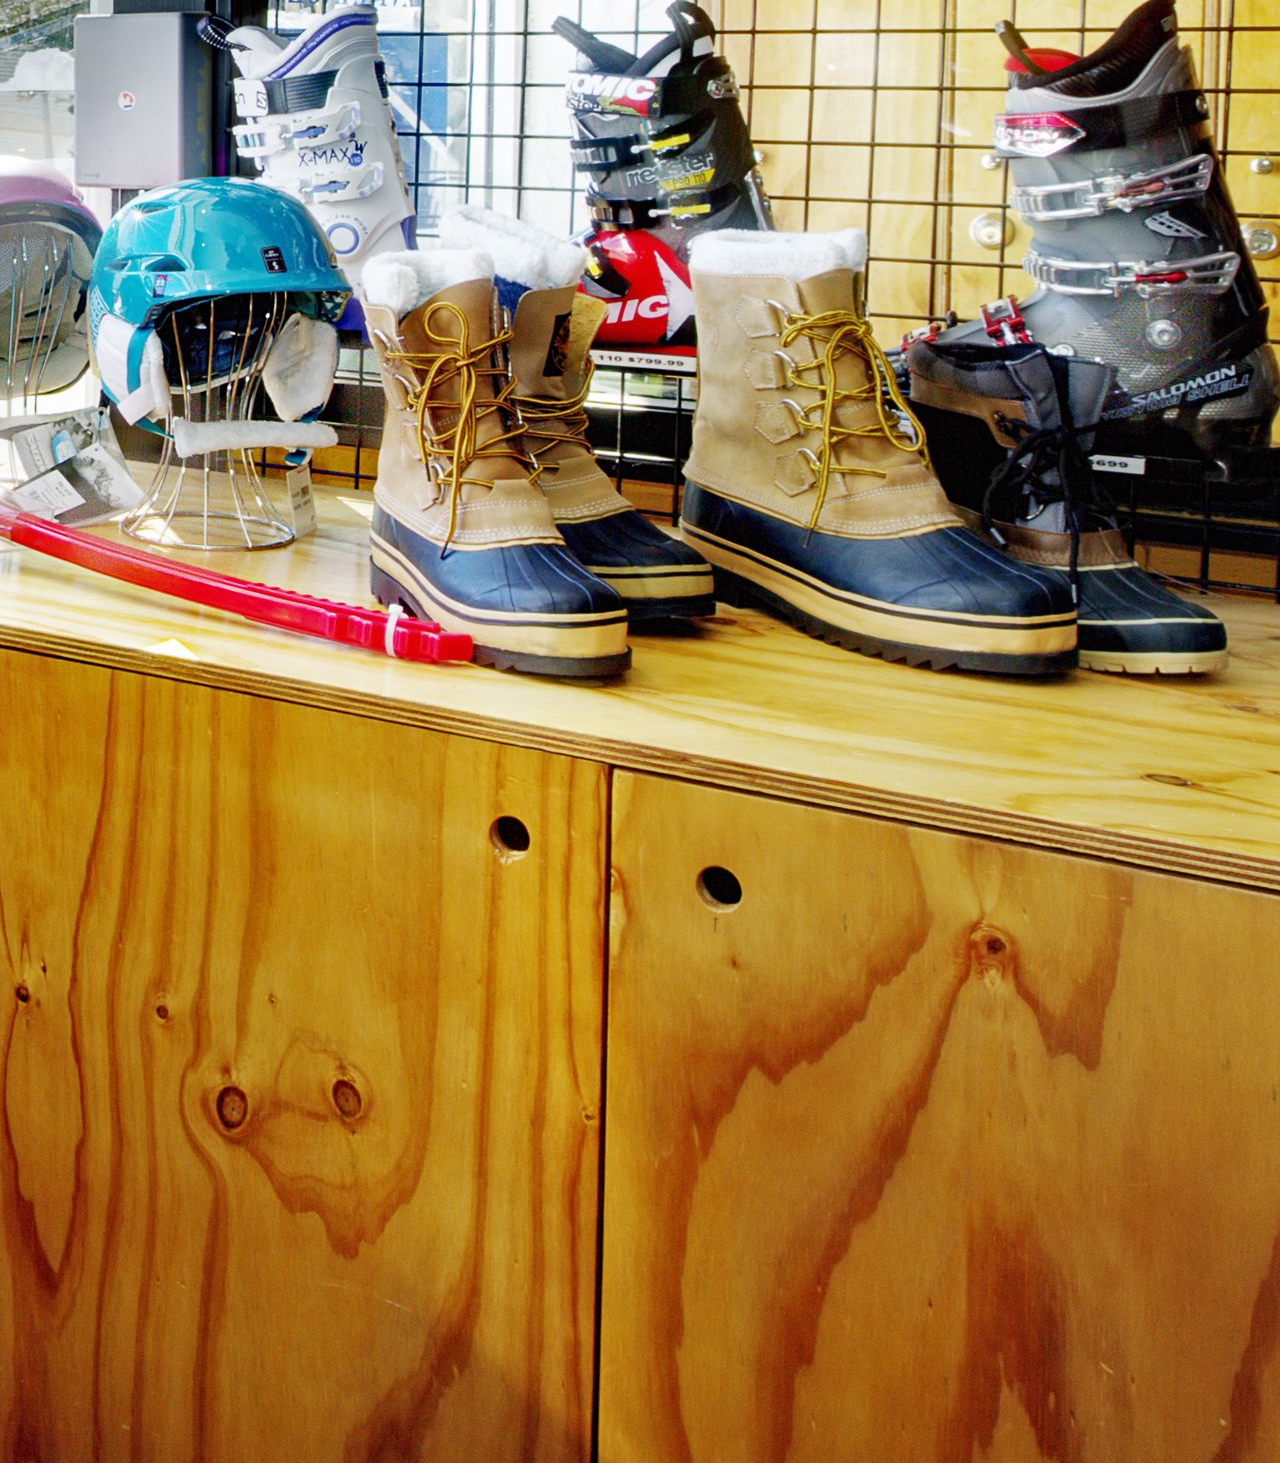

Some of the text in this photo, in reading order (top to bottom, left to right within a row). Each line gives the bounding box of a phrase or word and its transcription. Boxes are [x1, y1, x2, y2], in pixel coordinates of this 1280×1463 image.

[298, 147, 351, 168] X-MAX
[597, 354, 686, 369] 110 $799.99
[1132, 365, 1236, 404] SALOMON
